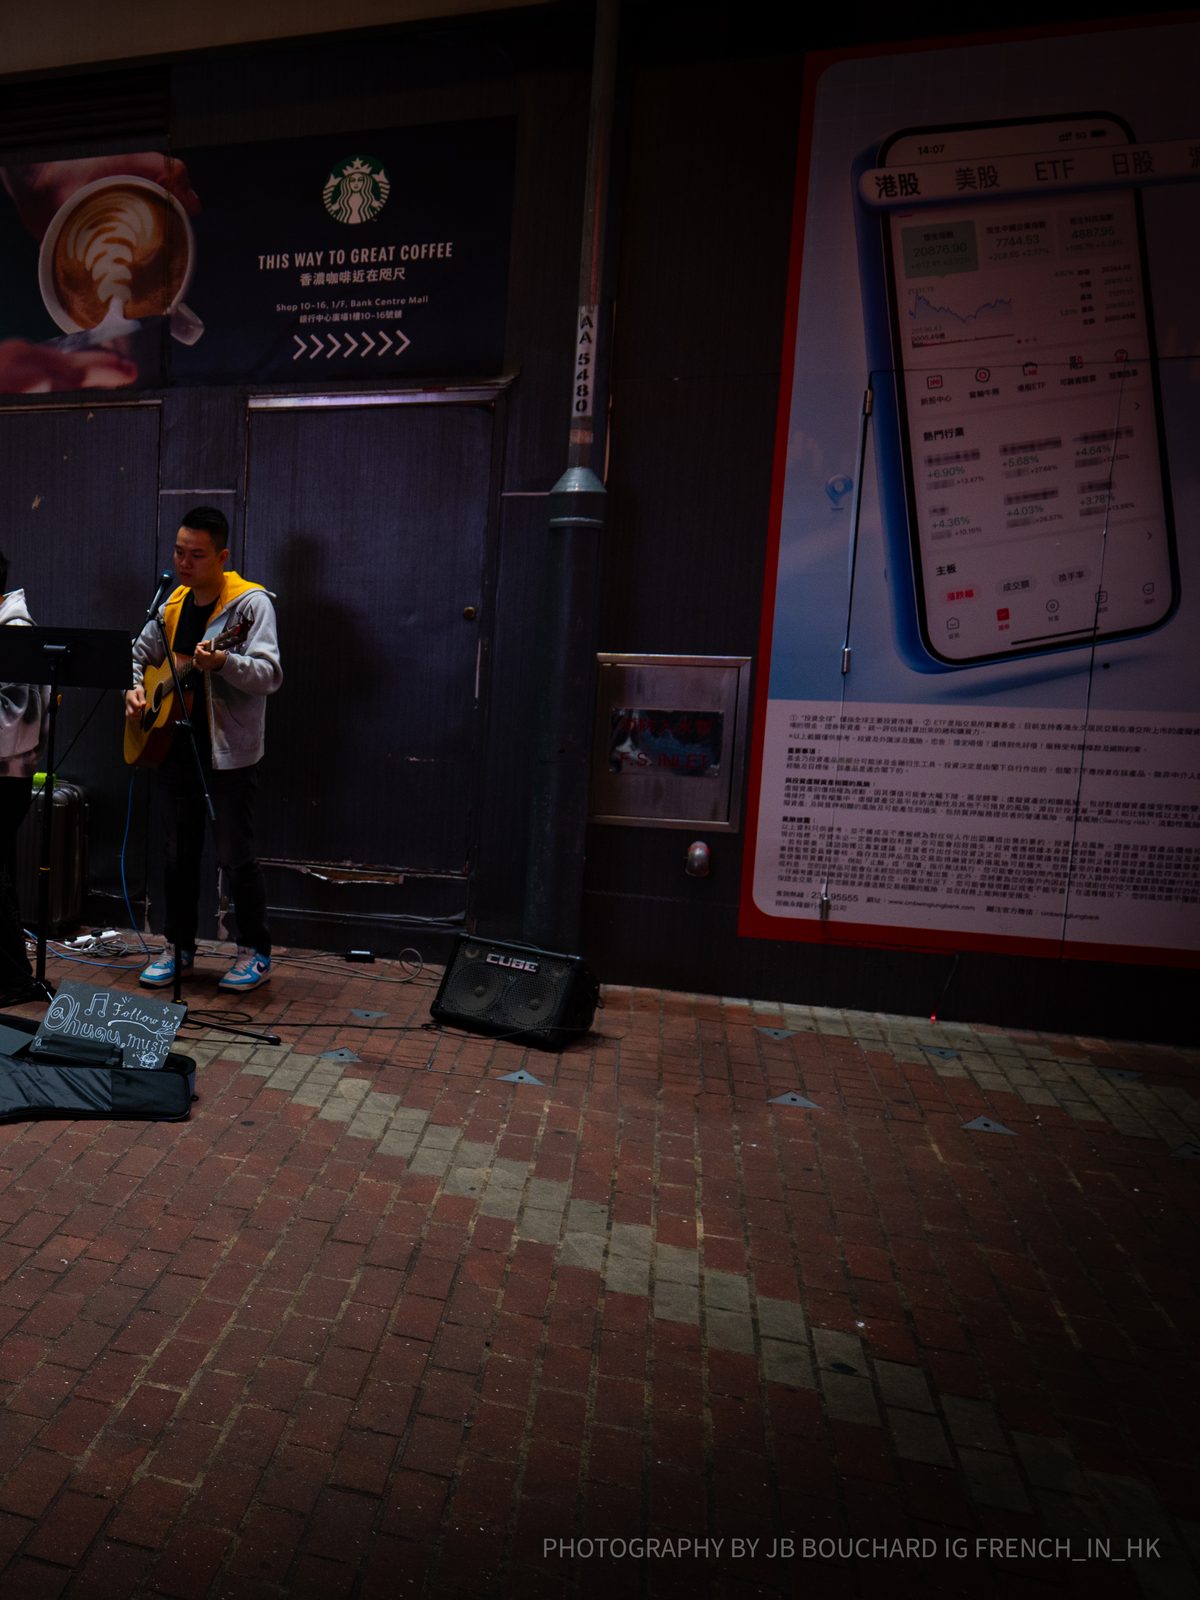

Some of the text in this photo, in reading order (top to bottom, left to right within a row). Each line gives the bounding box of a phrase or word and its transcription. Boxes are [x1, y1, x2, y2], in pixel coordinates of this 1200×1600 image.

[917, 144, 945, 156] 14:07
[1034, 159, 1075, 182] ETF
[1112, 151, 1155, 176] 日股
[875, 172, 921, 198] 港股
[955, 166, 1000, 191] 美股
[913, 241, 968, 258] 20876.90
[995, 234, 1040, 249] 7744.53
[258, 241, 453, 271] THIS WAY TO GREAT COFFEE
[299, 267, 406, 287] 香濃咖啡近在咫尺
[276, 303, 298, 312] Shop
[350, 298, 372, 308] Bank
[375, 297, 406, 306] Centre
[409, 295, 429, 304] Mall
[923, 427, 965, 442] 熱門行業
[1075, 443, 1112, 456] +4.64%
[1002, 456, 1040, 468] +5.68%
[927, 466, 966, 480] +6.90%
[1006, 505, 1044, 518] +4.03%
[932, 517, 970, 530] +4.36%
[936, 563, 957, 577] 主板
[658, 752, 711, 769] INLET
[485, 953, 540, 974] CUBE
[112, 1002, 159, 1025] Follow
